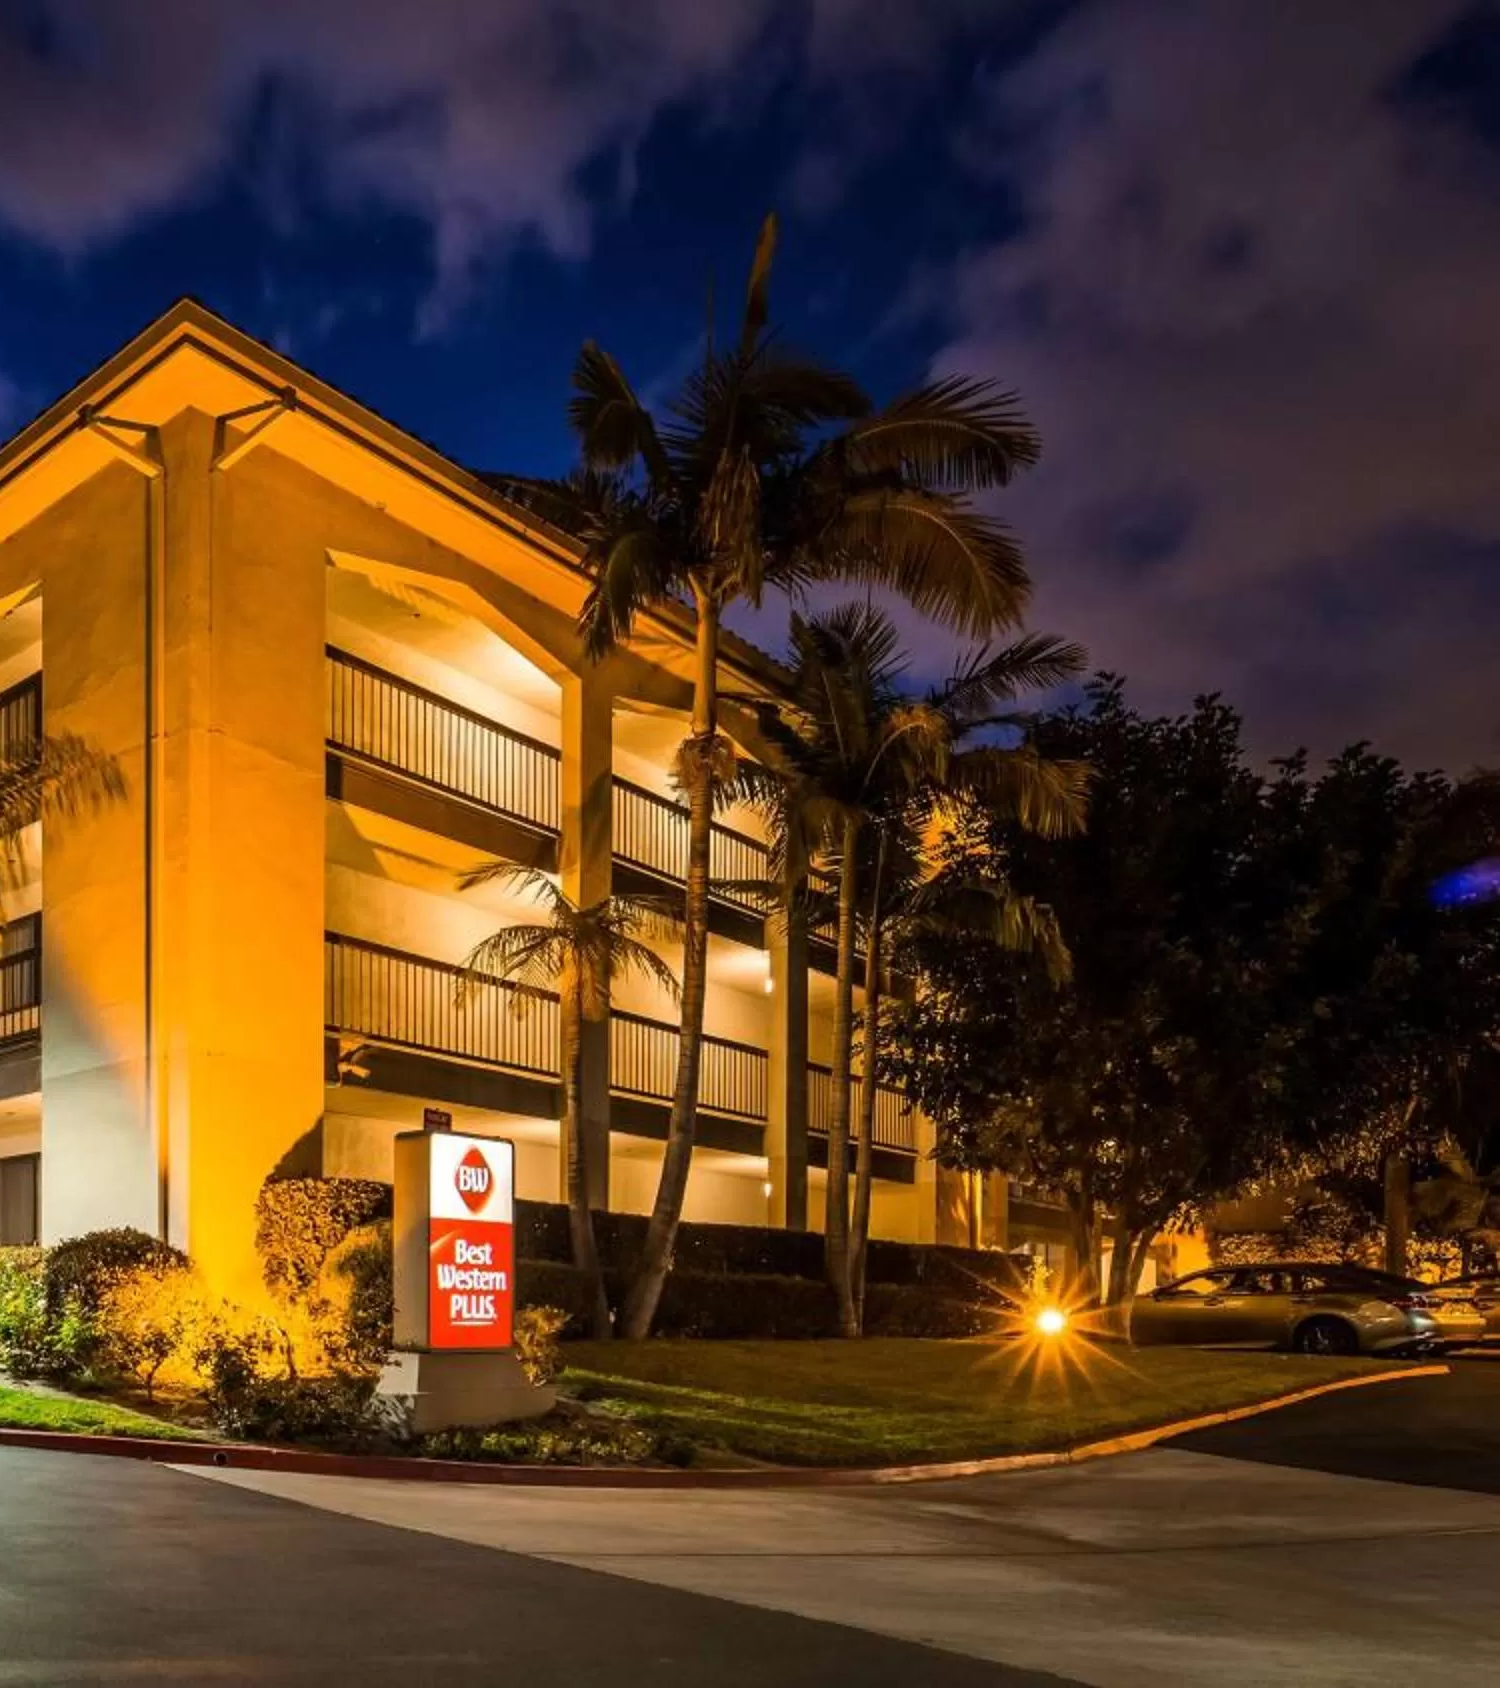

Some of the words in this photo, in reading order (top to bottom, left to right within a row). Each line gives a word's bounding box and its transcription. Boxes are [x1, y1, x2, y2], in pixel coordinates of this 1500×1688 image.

[459, 1165, 489, 1192] BW
[455, 1239, 493, 1265] Best
[437, 1264, 507, 1291] Western
